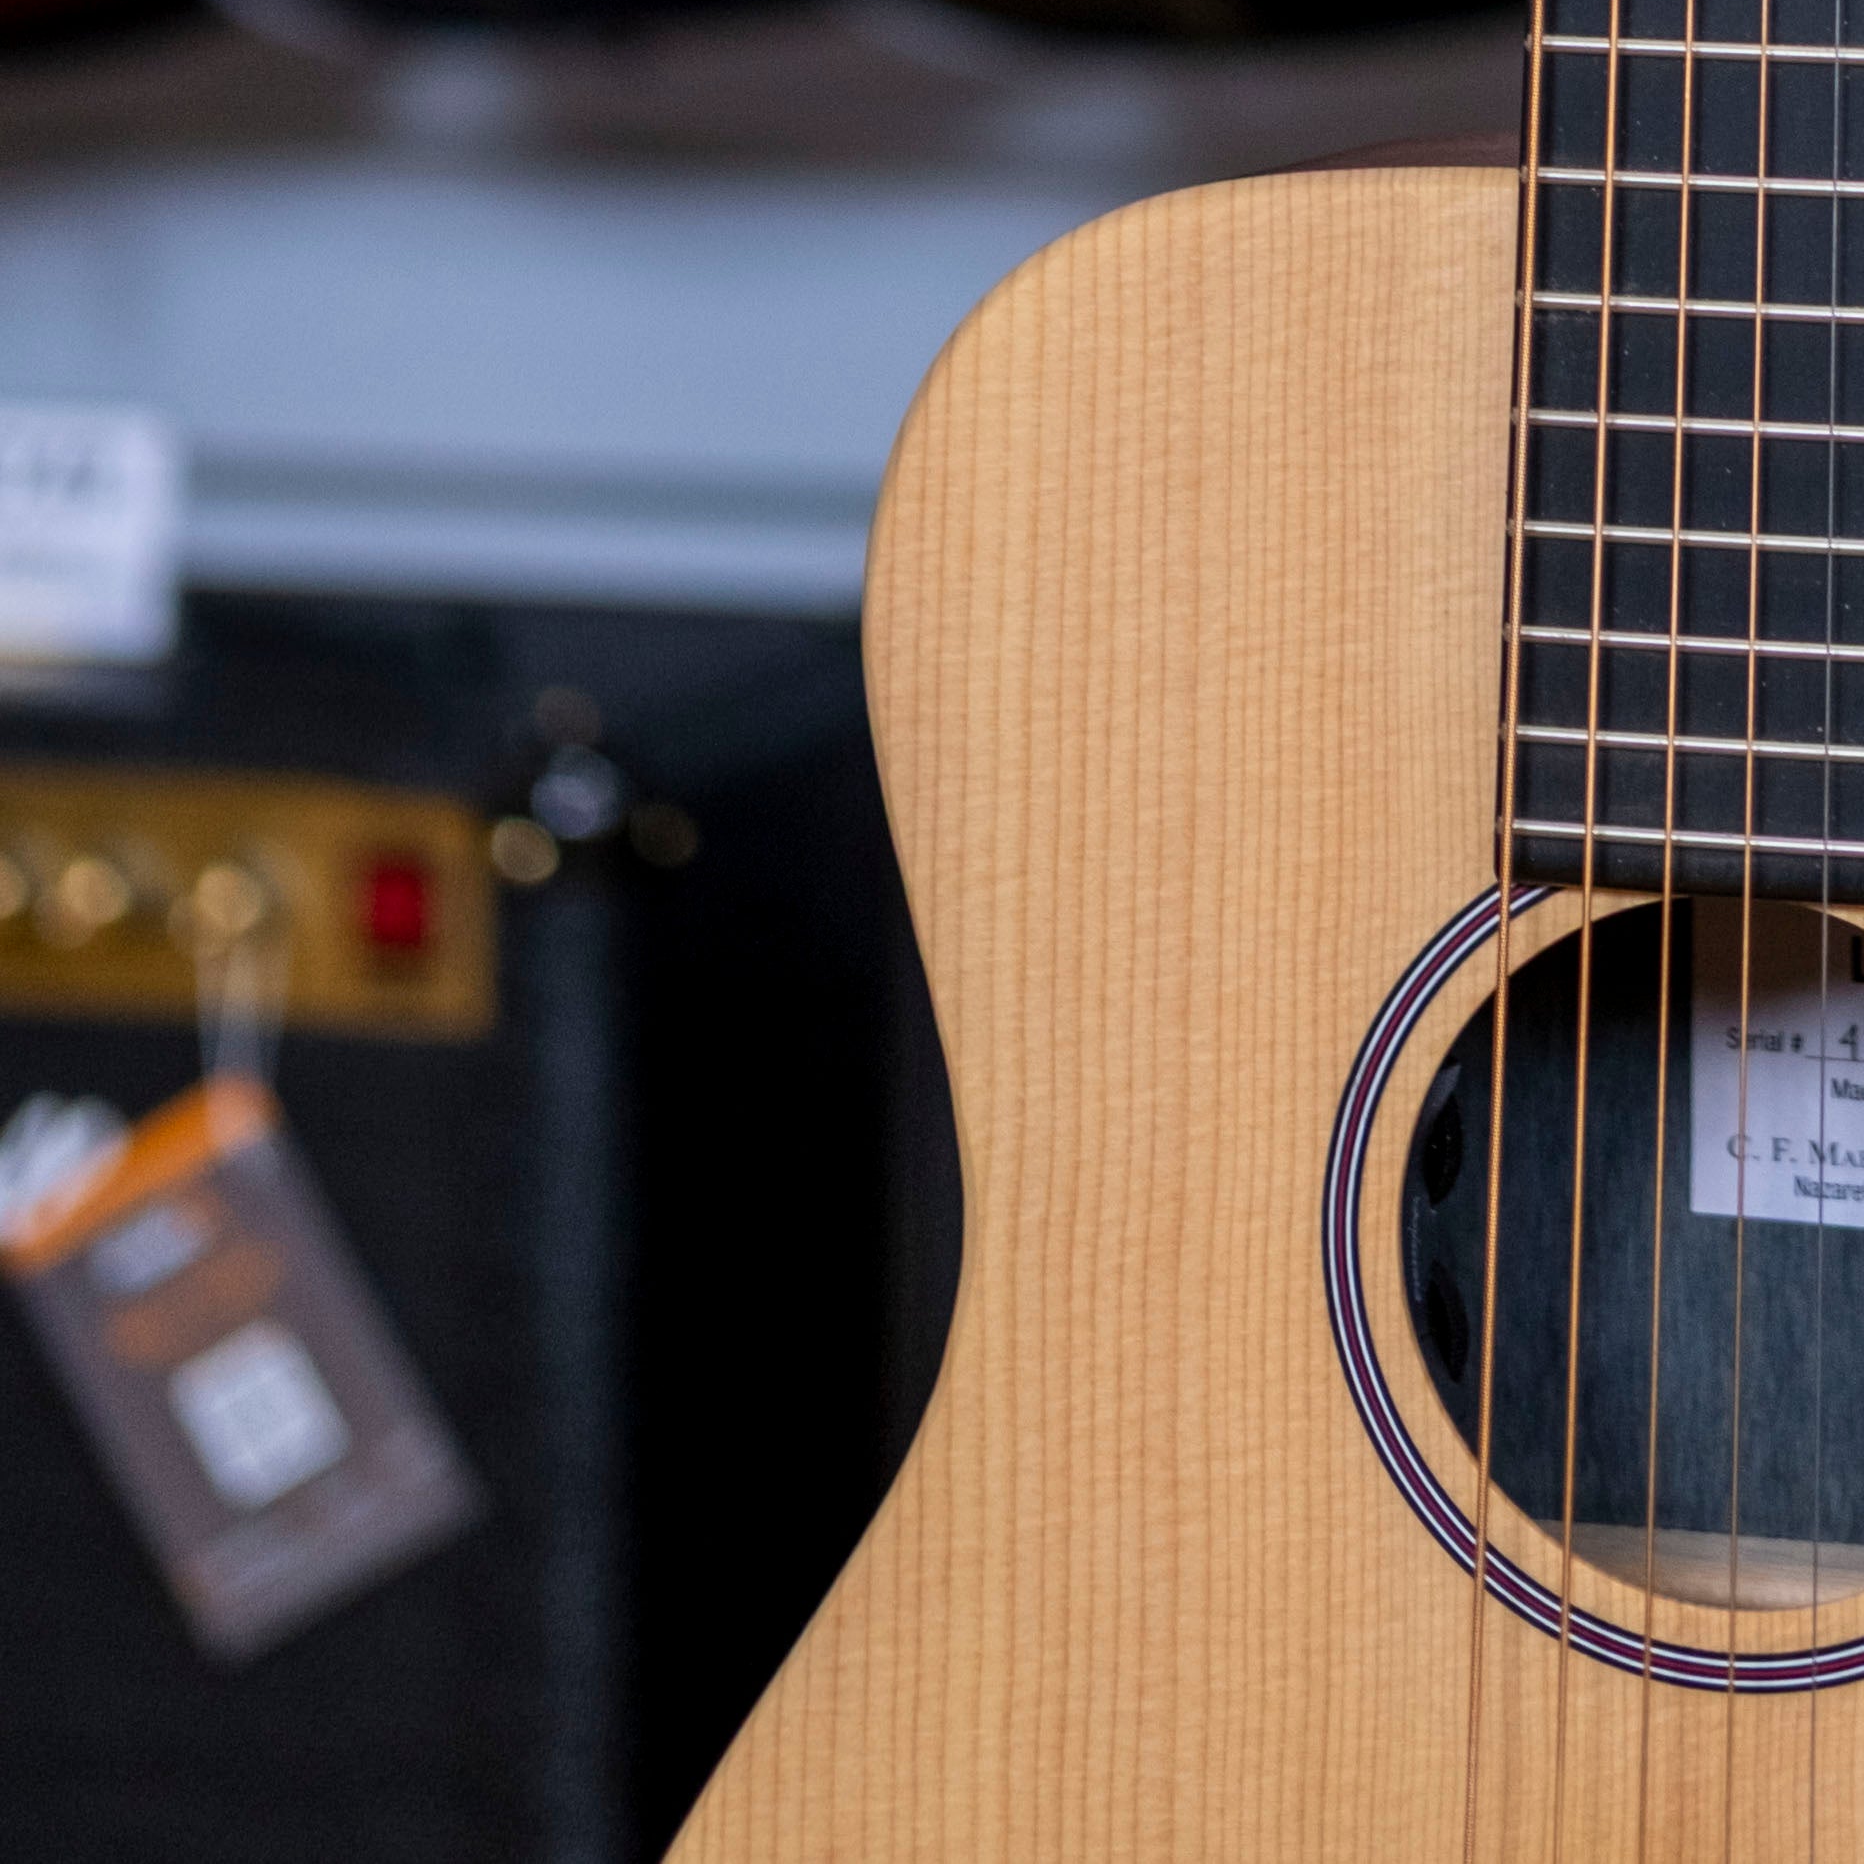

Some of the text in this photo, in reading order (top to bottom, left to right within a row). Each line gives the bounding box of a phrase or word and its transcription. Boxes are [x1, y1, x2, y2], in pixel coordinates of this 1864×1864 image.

[1790, 1032, 1804, 1054] #
[1726, 1133, 1761, 1161] C.
[1771, 1136, 1798, 1163] F.
